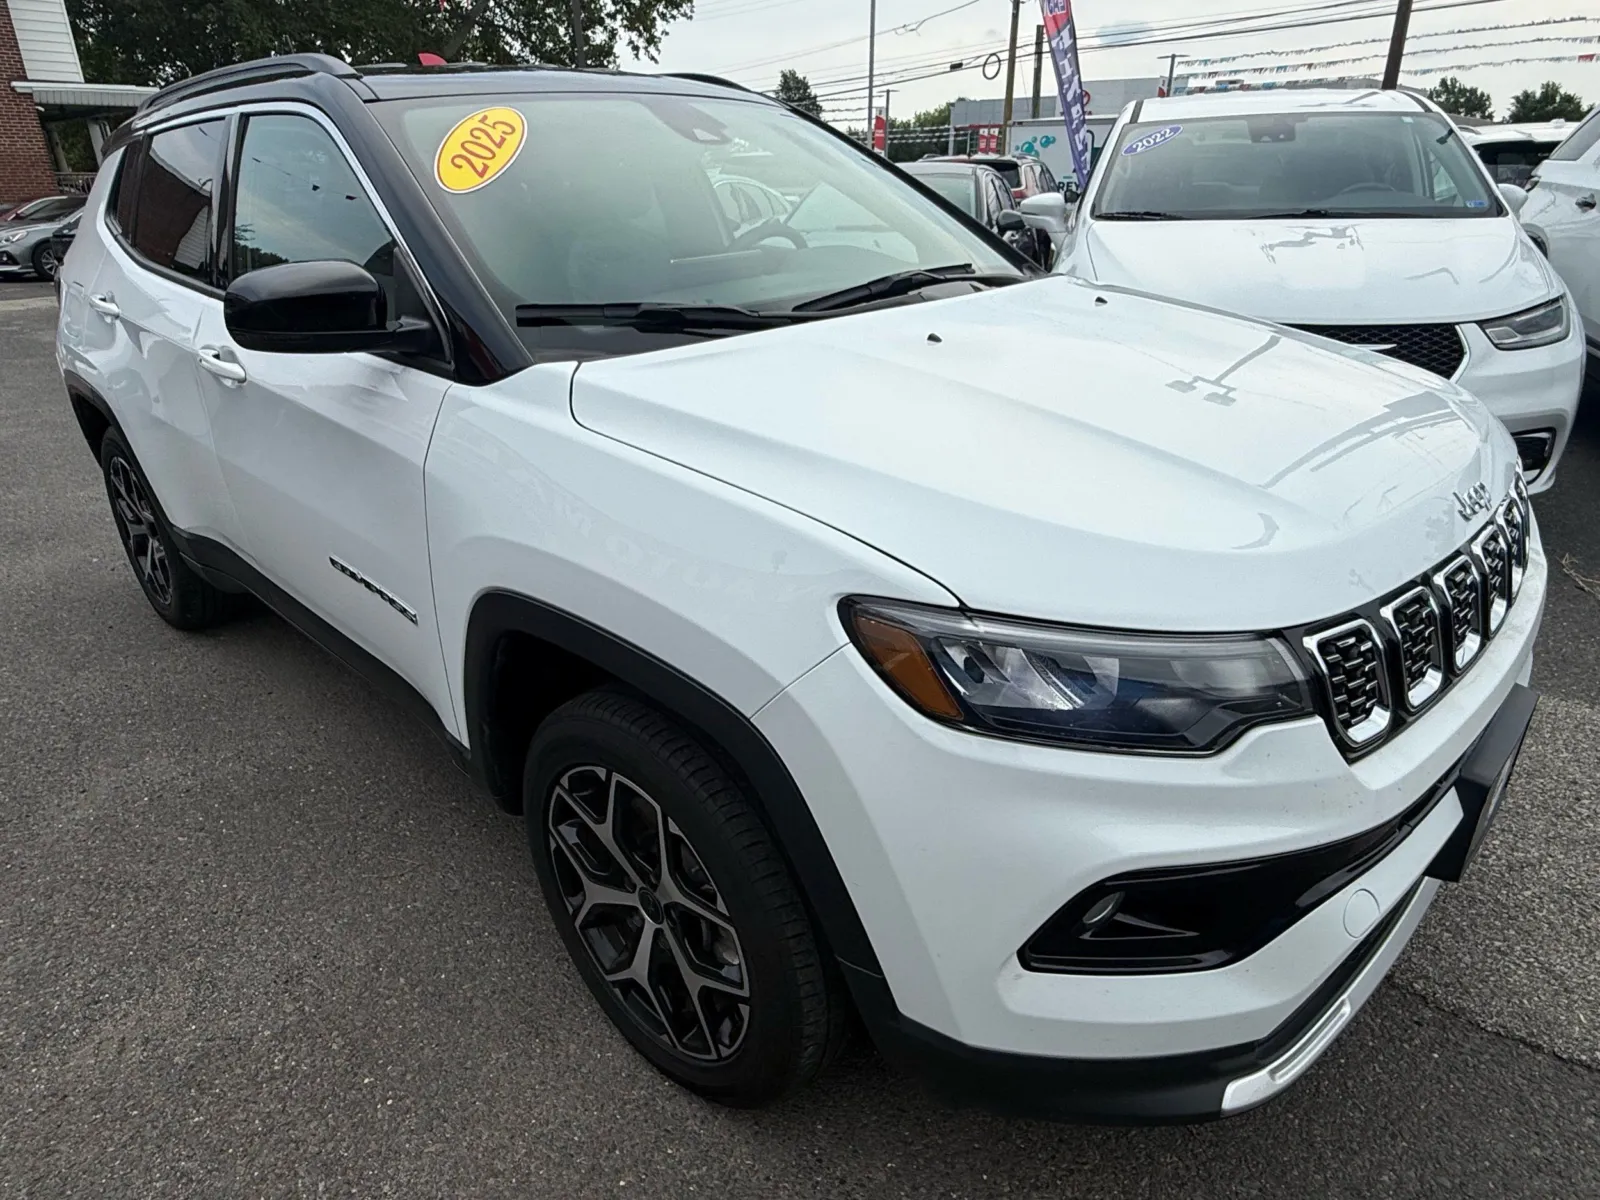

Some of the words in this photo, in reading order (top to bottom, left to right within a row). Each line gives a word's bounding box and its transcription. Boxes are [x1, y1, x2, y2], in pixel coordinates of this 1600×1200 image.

[450, 114, 517, 179] 2025
[1133, 128, 1175, 152] 2022
[1452, 481, 1492, 522] Jeep
